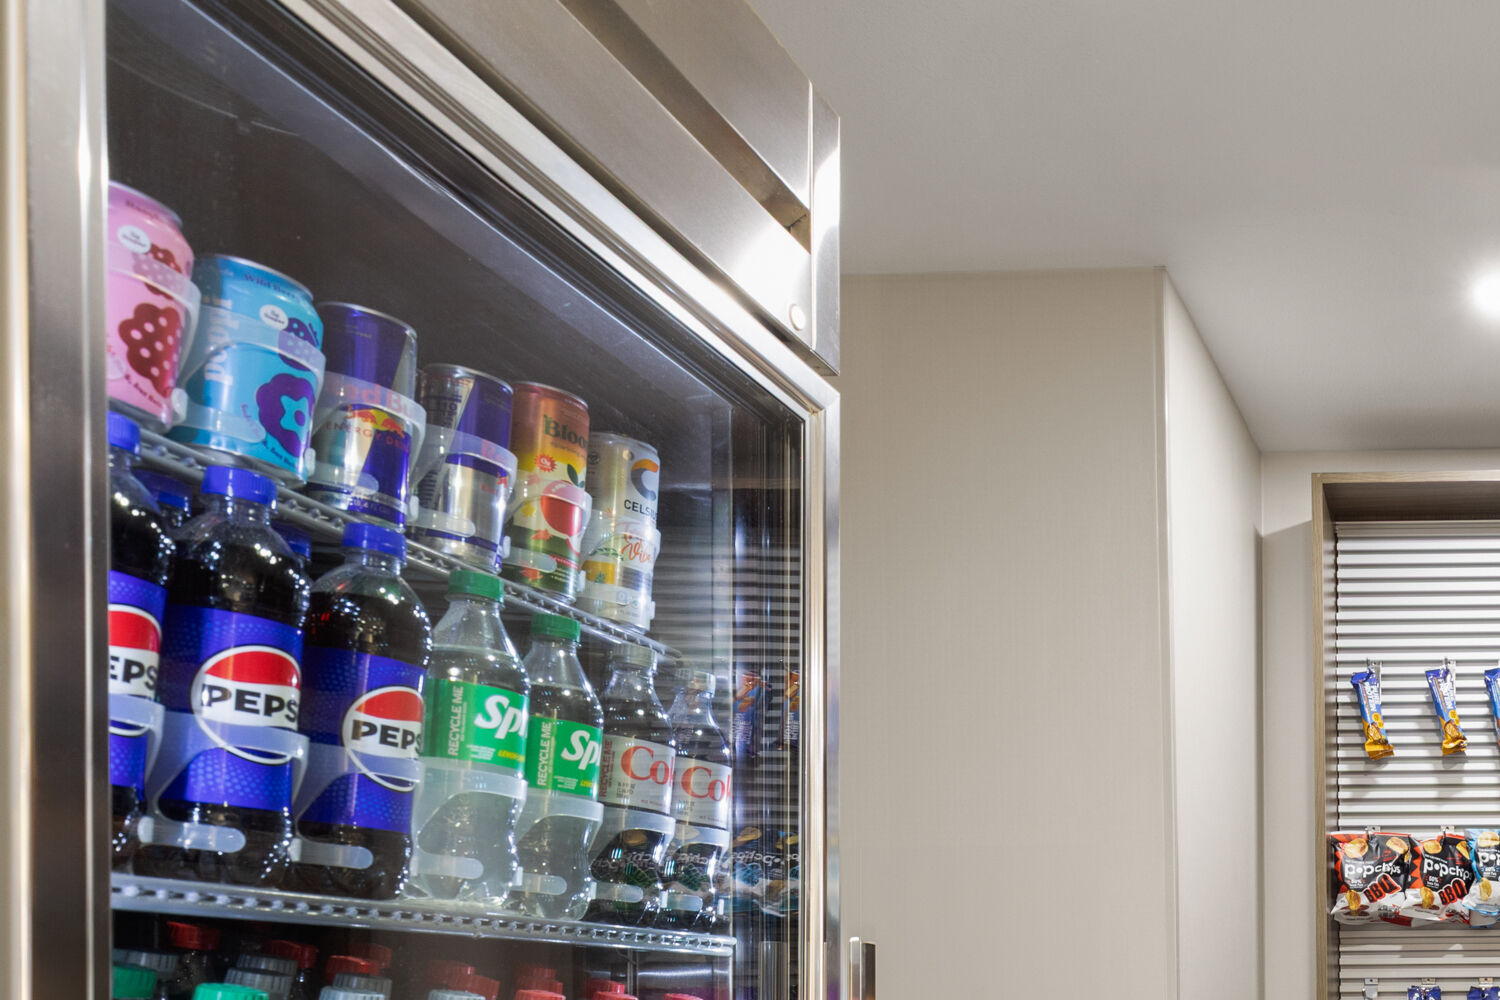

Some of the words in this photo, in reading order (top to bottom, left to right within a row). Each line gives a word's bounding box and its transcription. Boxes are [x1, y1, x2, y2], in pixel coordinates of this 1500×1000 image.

[448, 704, 462, 756] RECYCLE
[456, 686, 464, 703] ME
[543, 721, 551, 736] ME
[537, 736, 550, 786] RECYCLE
[600, 758, 611, 798] RECYCLE
[1344, 861, 1402, 879] popchips
[1364, 875, 1402, 903] BBQ
[1439, 879, 1469, 905] BBQ
